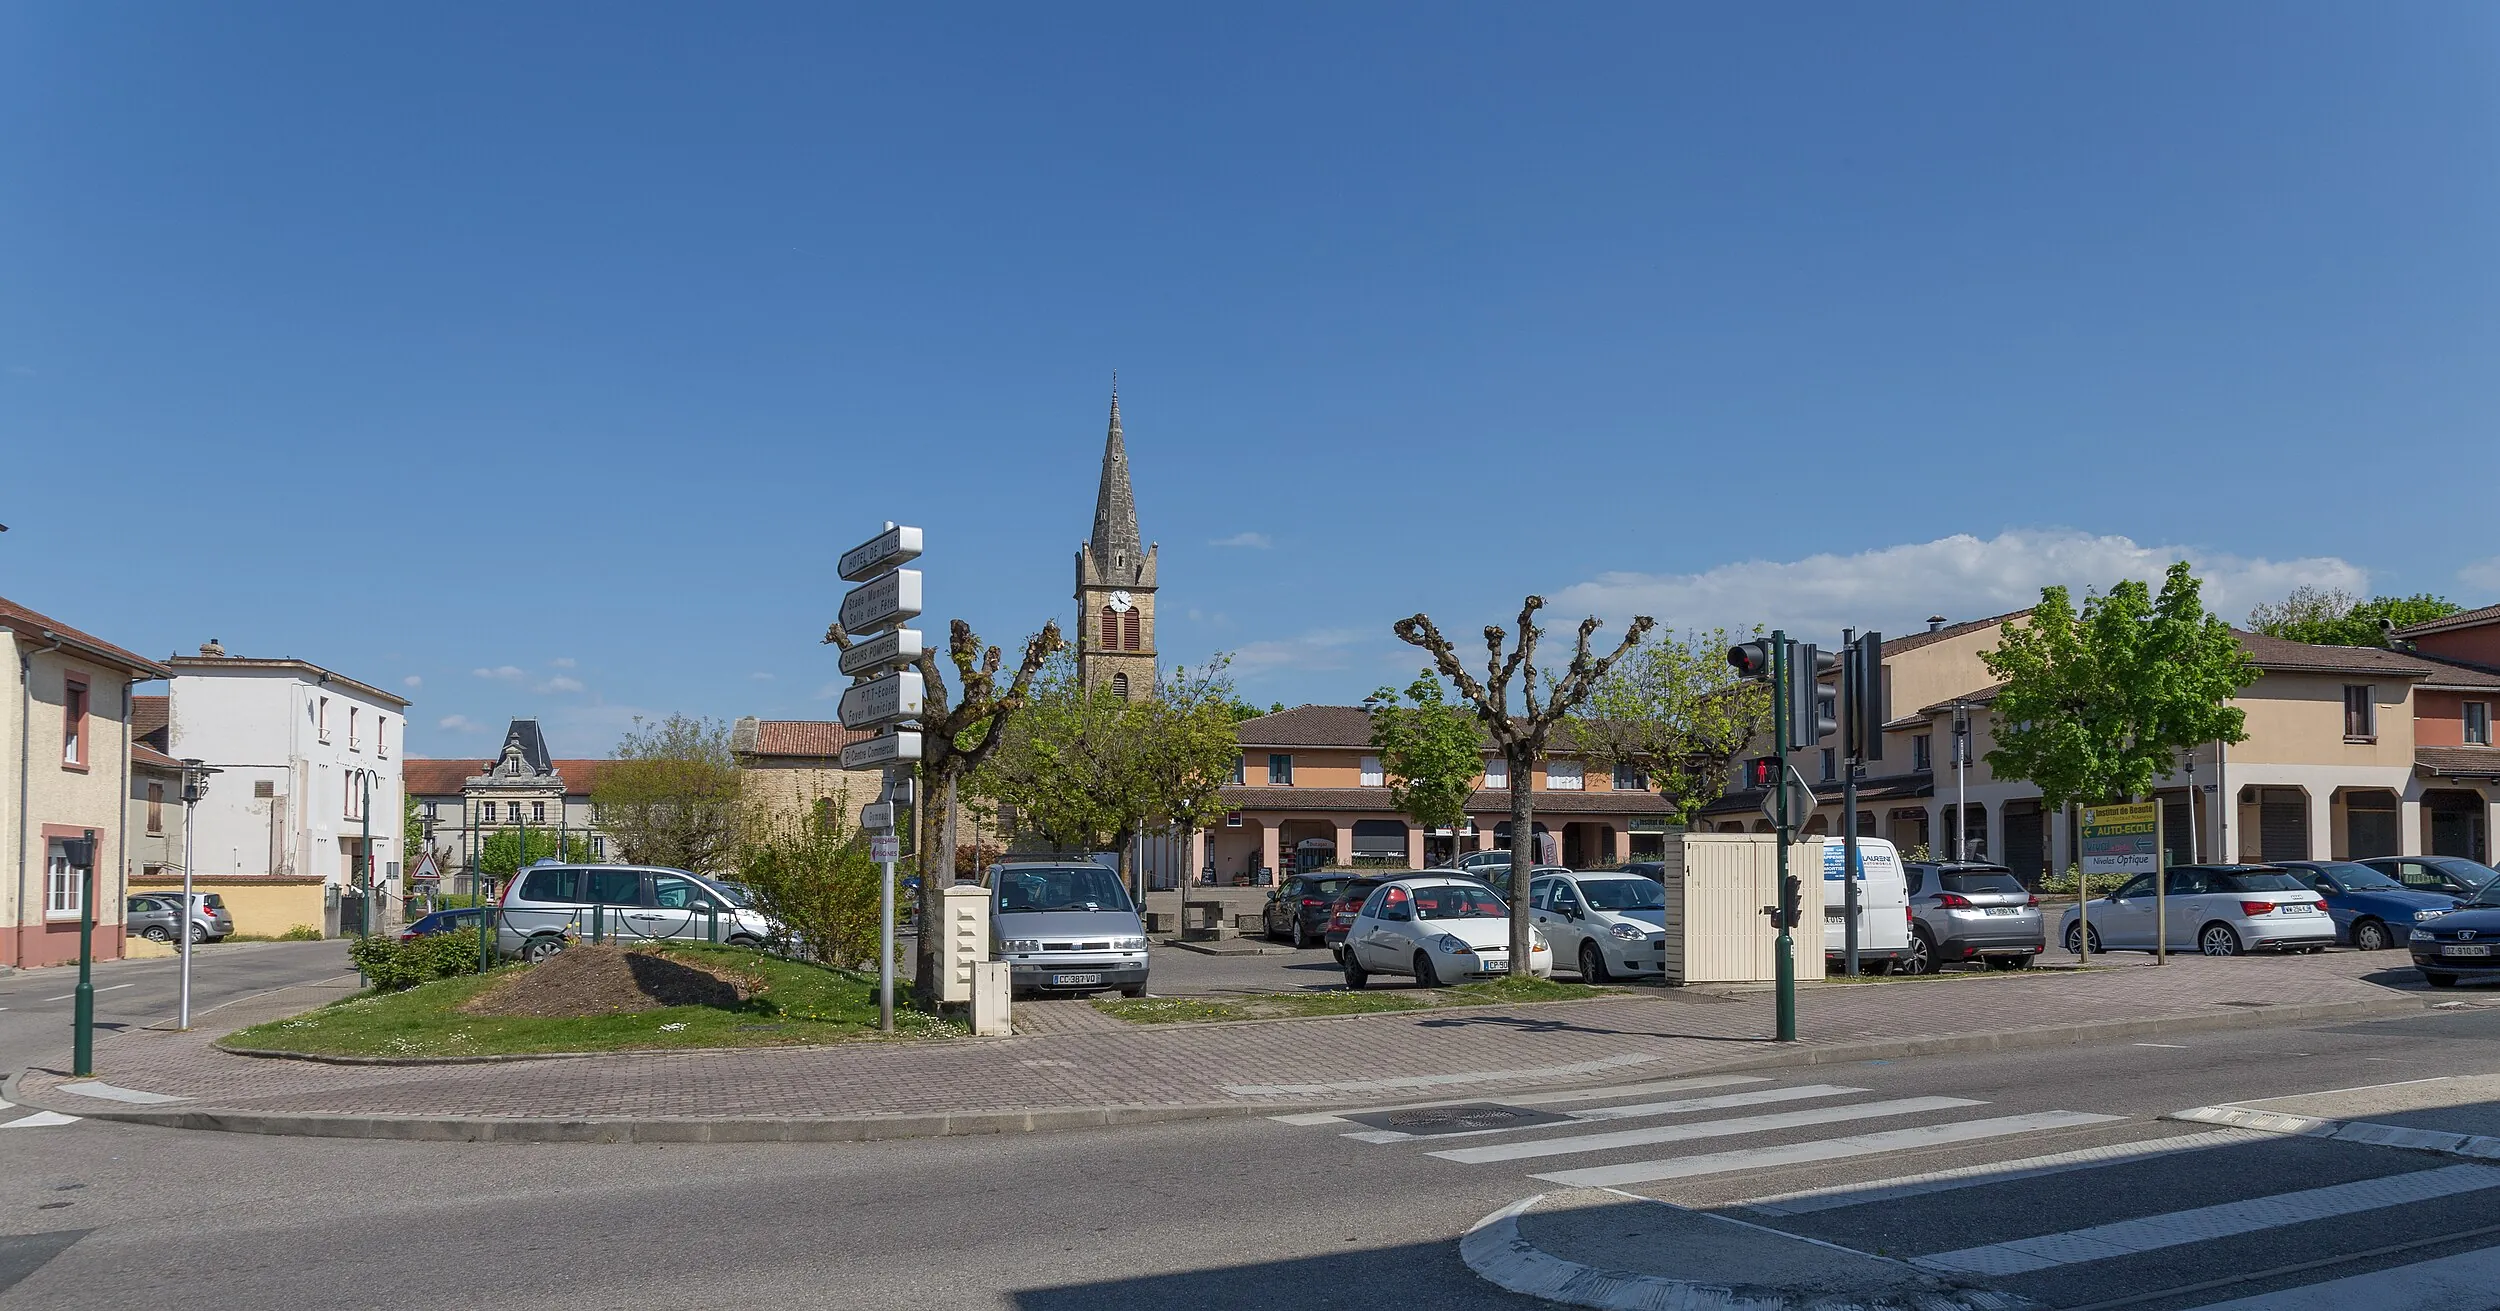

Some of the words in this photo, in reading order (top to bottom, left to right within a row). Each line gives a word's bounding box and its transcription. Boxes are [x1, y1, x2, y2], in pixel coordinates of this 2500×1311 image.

[848, 549, 867, 570] HOTEL
[869, 545, 878, 560] DE
[881, 534, 898, 554] VILLE
[848, 596, 864, 611] Stade
[868, 583, 897, 601] Municipal
[849, 611, 864, 625] Salle
[867, 605, 877, 618] des
[844, 648, 867, 668] SAPEURS
[869, 637, 897, 658] POMPIERS
[848, 709, 865, 722] Foyer
[867, 696, 898, 717] Municipal
[851, 749, 867, 762] Centre
[868, 741, 896, 758] Commercial
[2096, 808, 2119, 817] Institut
[2120, 807, 2128, 815] de
[2130, 804, 2153, 815] Beauté
[2097, 824, 2154, 836] AUTO-ECOLE
[2117, 855, 2149, 866] Optique
